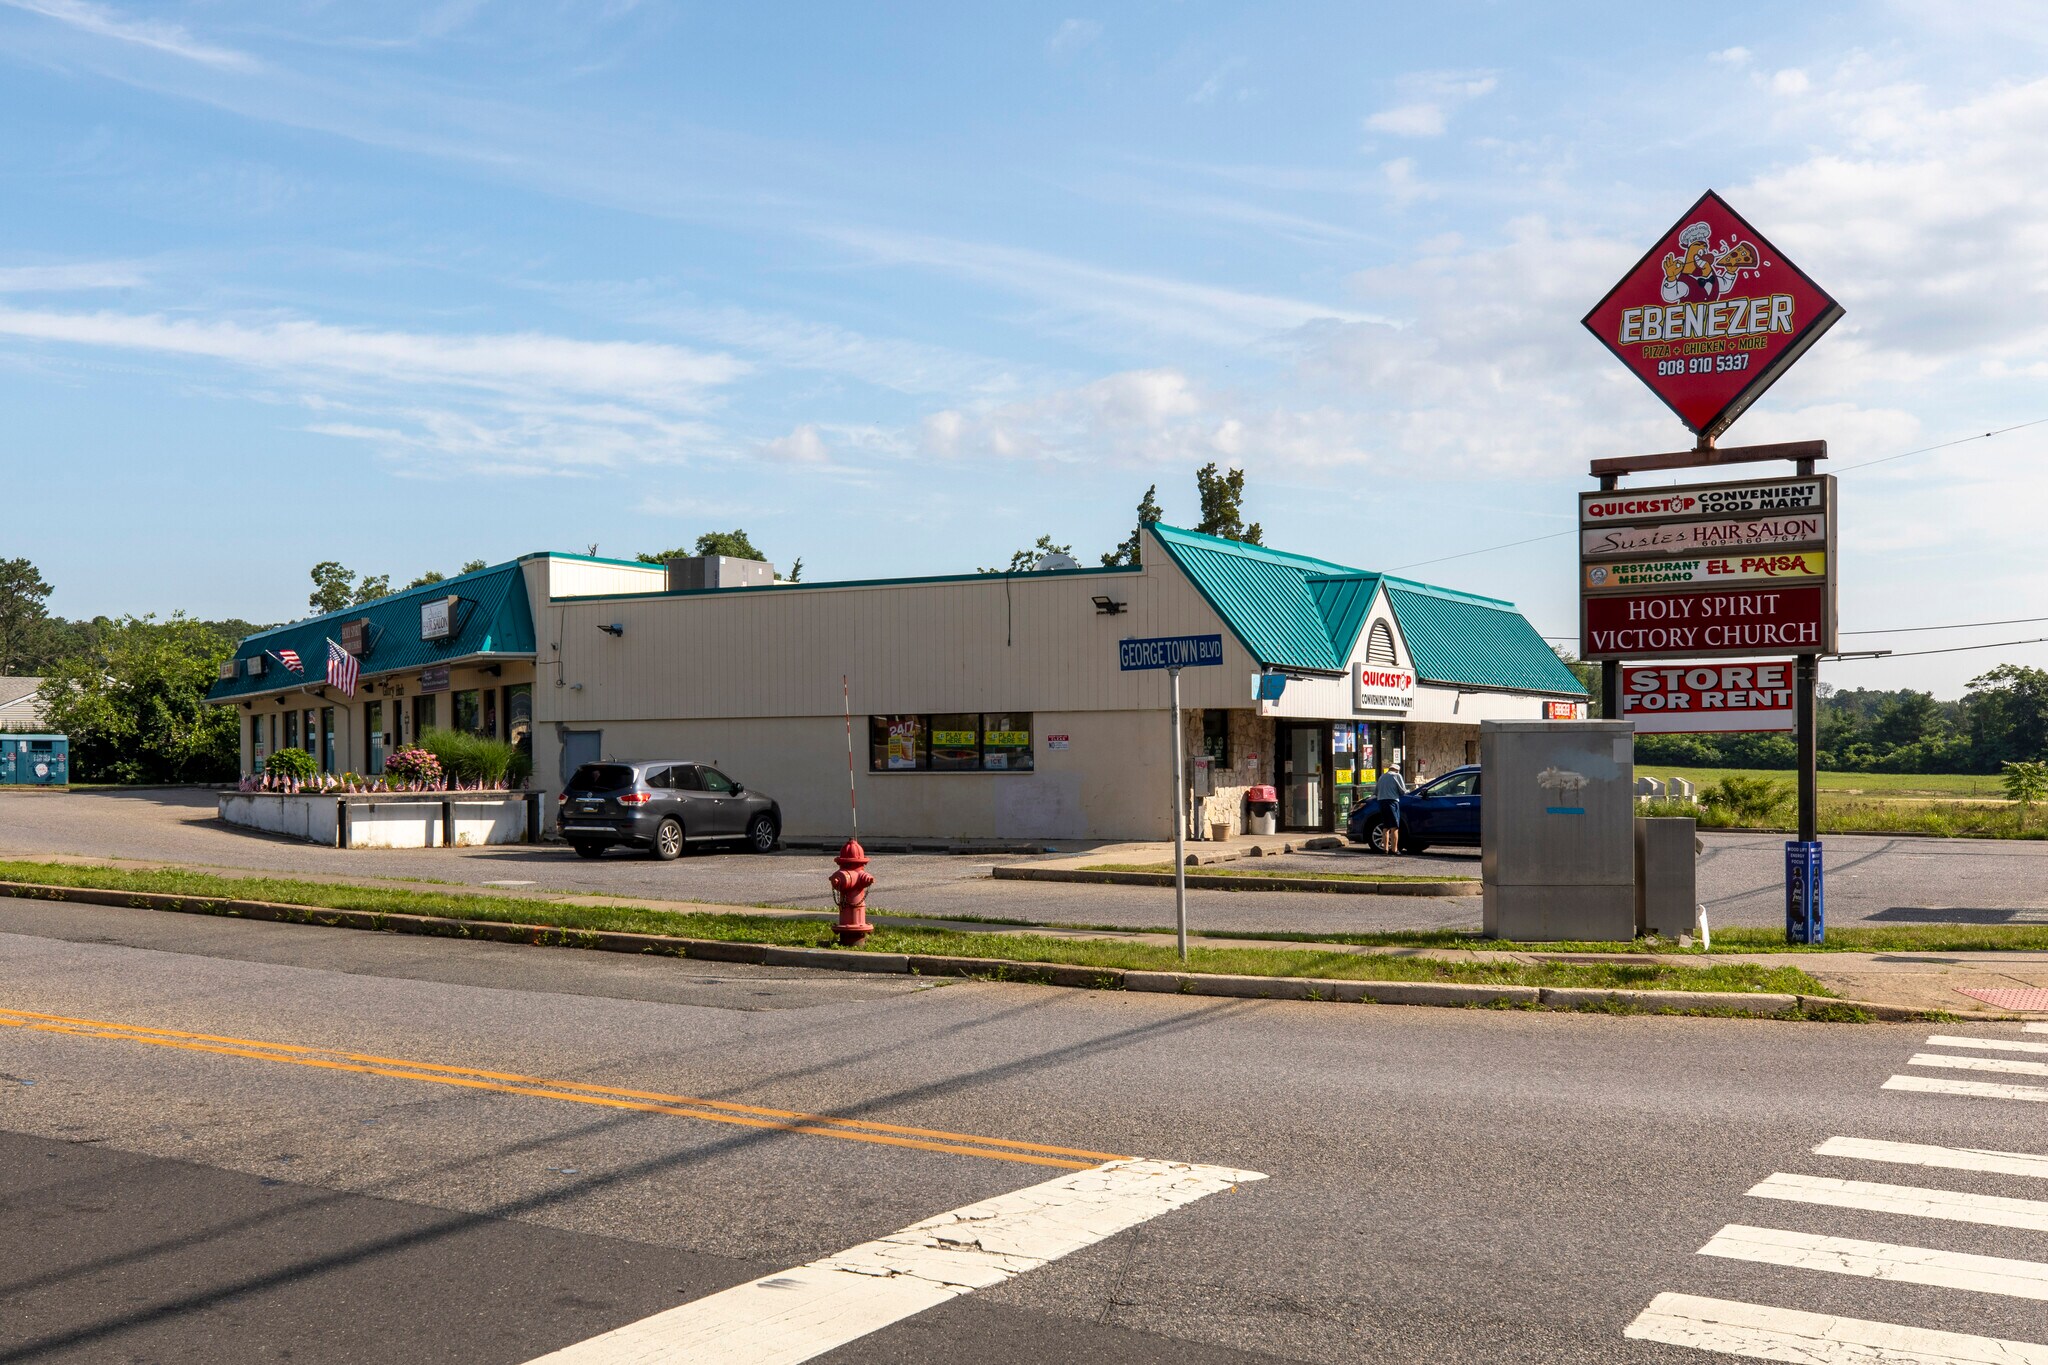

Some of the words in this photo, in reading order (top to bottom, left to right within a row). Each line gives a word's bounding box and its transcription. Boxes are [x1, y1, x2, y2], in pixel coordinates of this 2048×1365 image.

[1619, 294, 1793, 345] EBENEZER
[1643, 344, 1671, 358] PIZZA
[1683, 340, 1725, 356] CHICKEN
[1738, 337, 1767, 351] MORE
[1658, 359, 1684, 376] 908
[1689, 356, 1711, 374] 910
[1716, 354, 1749, 374] 5337
[1698, 485, 1815, 503] CONVENIENT
[1702, 500, 1753, 513] FOOD
[1760, 497, 1812, 510] MART
[1693, 525, 1740, 541] HAIR
[1747, 519, 1817, 539] SALON
[1701, 534, 1807, 547] 609-660-7677
[1612, 561, 1700, 575] RESTAURANT
[1706, 559, 1735, 575] EL
[1741, 556, 1817, 577] PAISA
[1618, 572, 1693, 584] MEXICANO
[1628, 598, 1694, 621] HOLY
[1701, 594, 1780, 617] SPIRIT
[1592, 627, 1699, 650] VICTORY
[1704, 622, 1818, 647] CHURCH
[1121, 640, 1198, 667] GEORGETOWN
[1199, 640, 1221, 658] BLVD
[1630, 666, 1785, 692] STORE
[1362, 693, 1387, 706] CONVENIENT
[1388, 695, 1400, 707] FOOD
[1401, 697, 1413, 708] MART
[1624, 692, 1690, 710] FOR
[1701, 689, 1792, 708] RENT
[890, 720, 914, 736] 24/7
